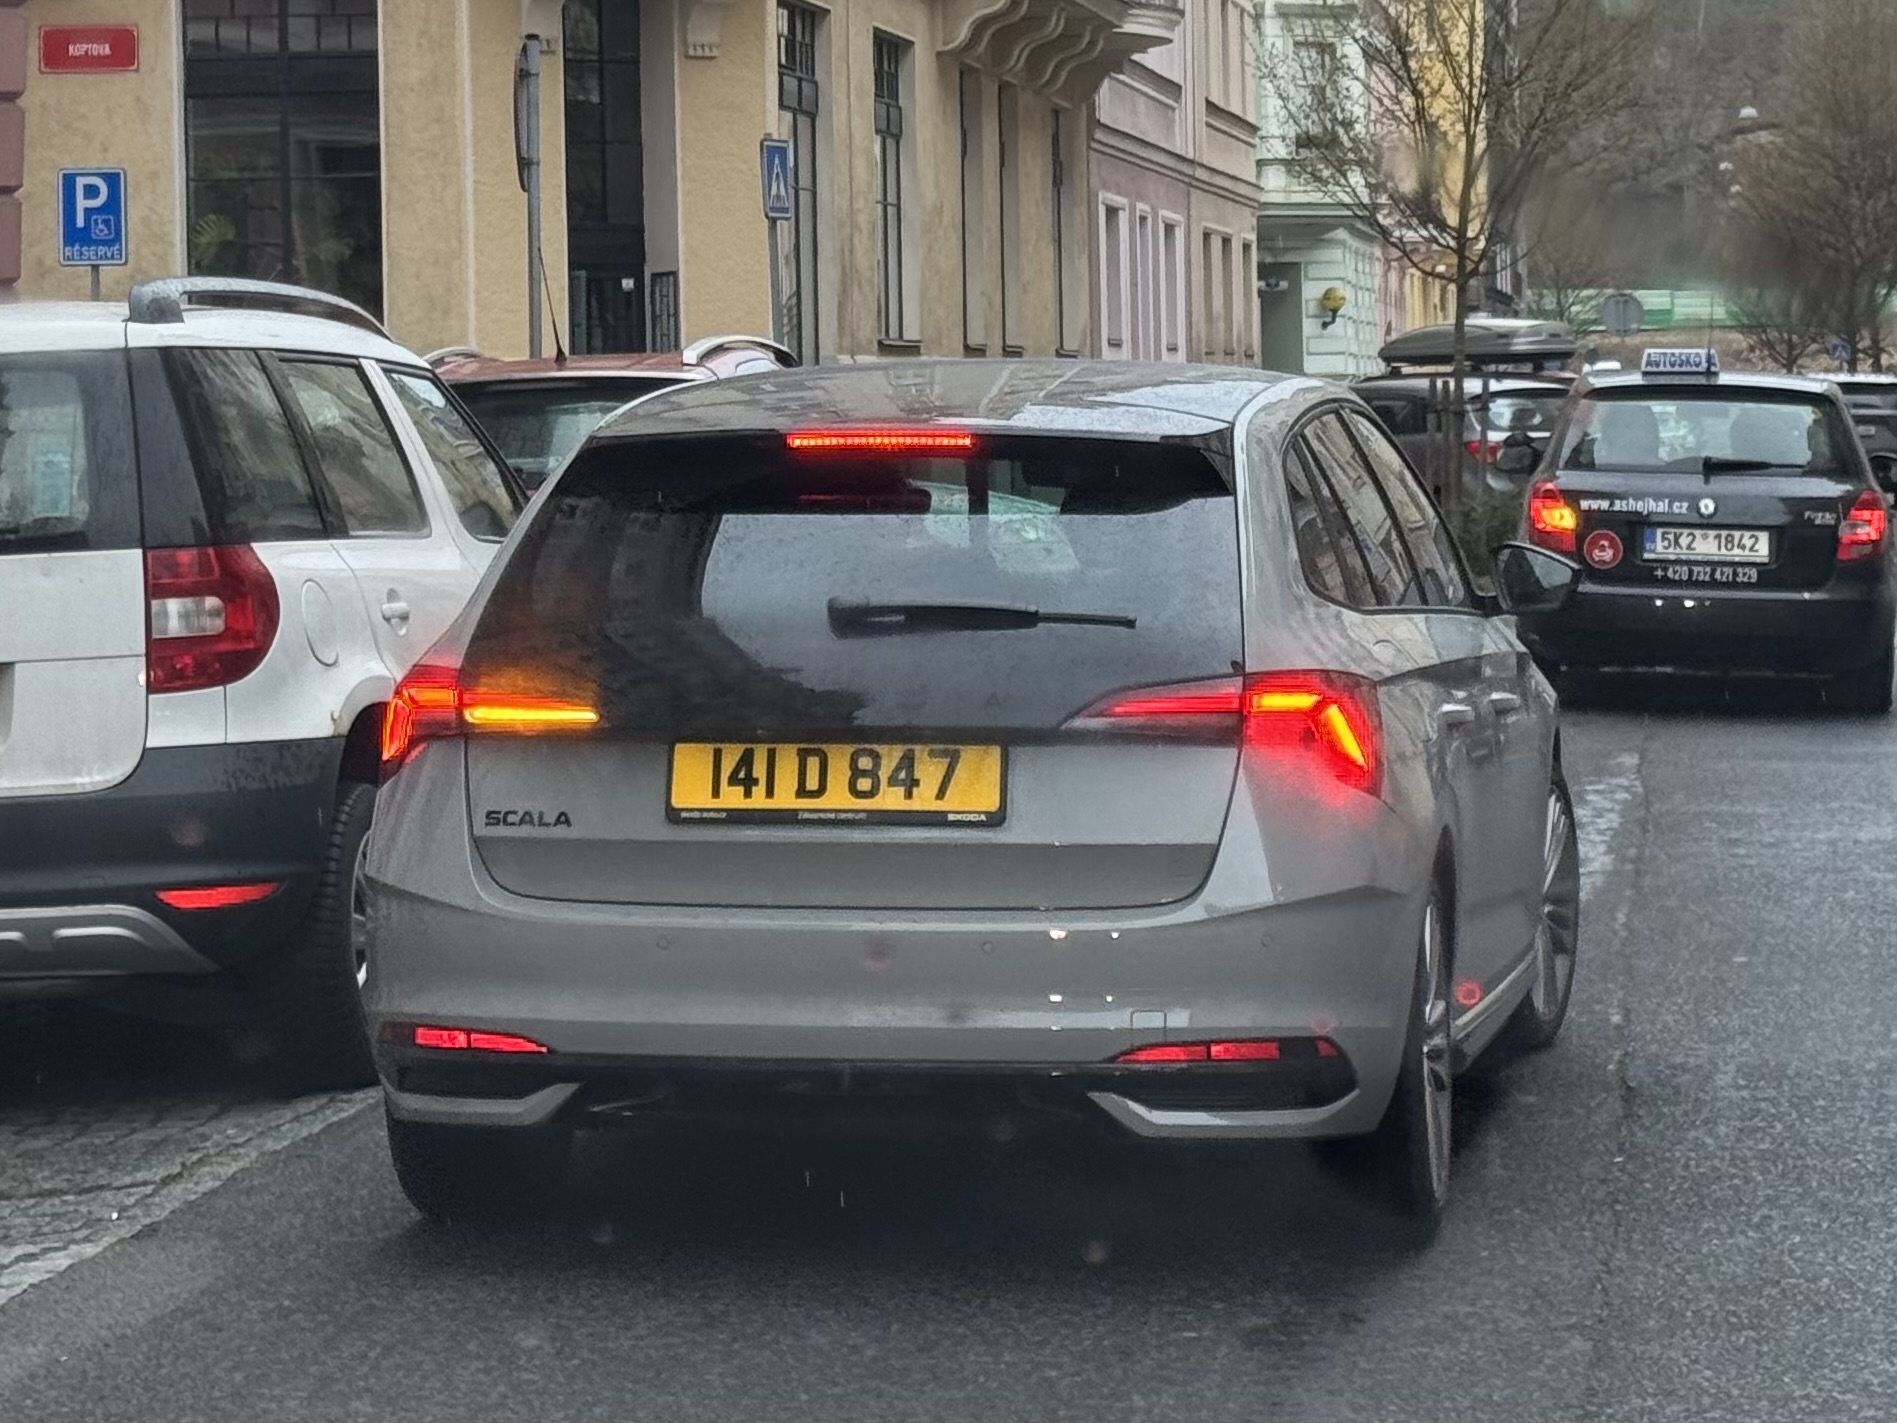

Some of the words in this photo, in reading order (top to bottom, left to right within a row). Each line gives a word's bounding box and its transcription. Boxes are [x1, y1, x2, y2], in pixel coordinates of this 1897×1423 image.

[75, 176, 109, 229] P
[64, 244, 121, 261] RÉSERVÉ
[1645, 352, 1718, 369] AUTOSKOA
[1661, 531, 1697, 551] 5K2
[1713, 533, 1759, 553] 1842
[711, 747, 776, 800] 141
[795, 747, 829, 800] D
[848, 747, 961, 801] 847
[485, 809, 572, 828] SCALA
